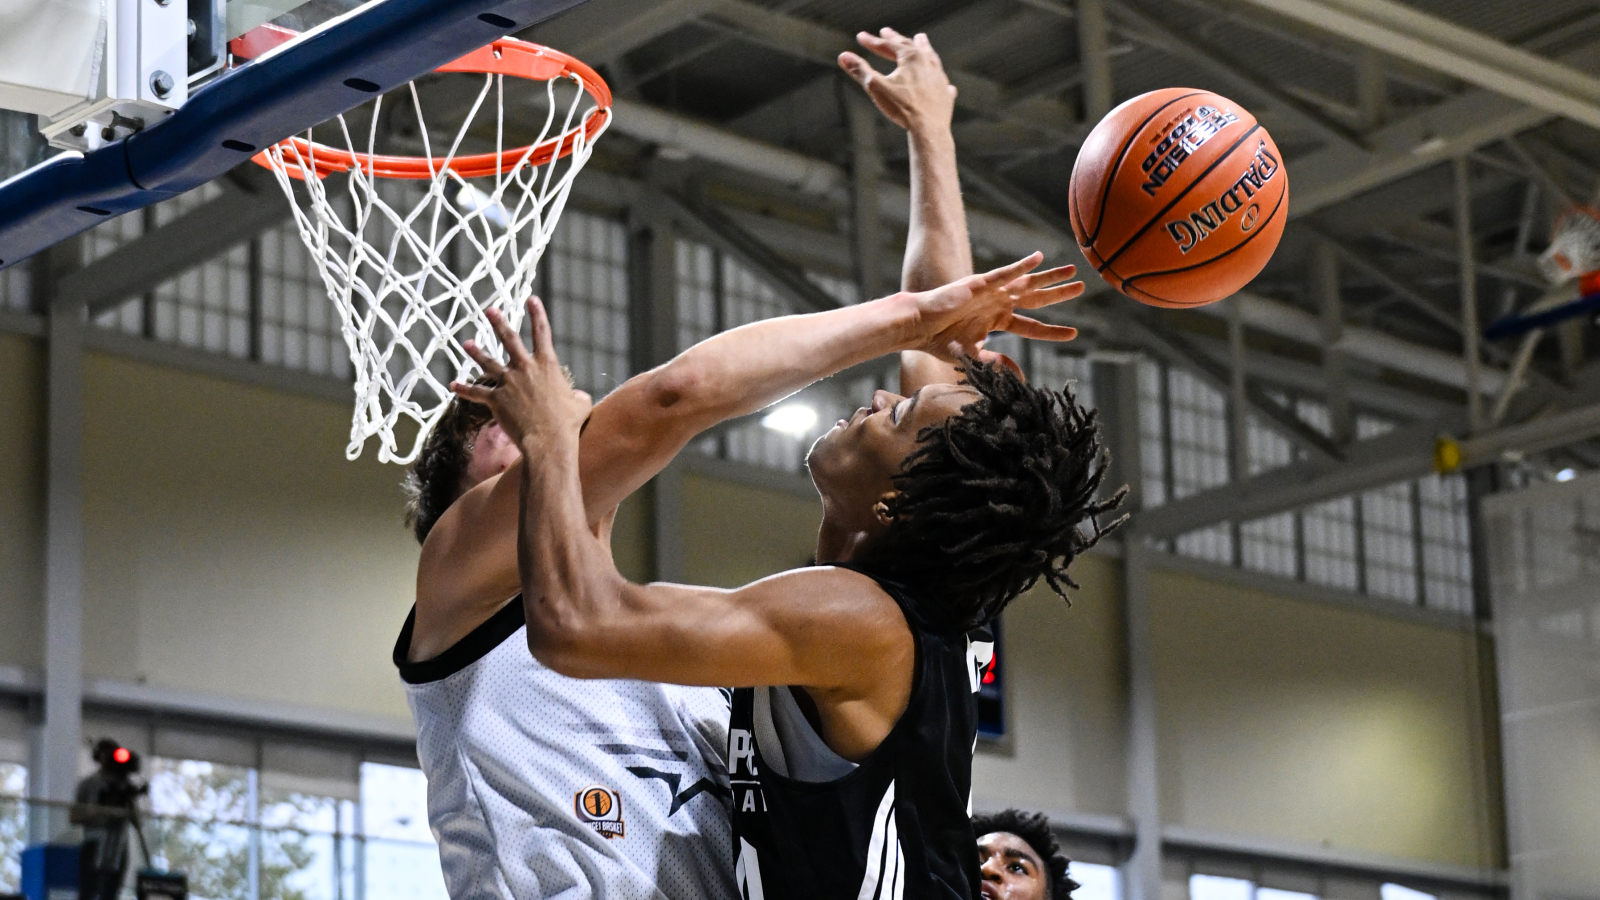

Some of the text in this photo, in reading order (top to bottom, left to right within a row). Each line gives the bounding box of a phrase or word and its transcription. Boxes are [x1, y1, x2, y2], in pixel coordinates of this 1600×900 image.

[1140, 108, 1240, 197] PRECISION
[1141, 114, 1199, 173] 1000
[1165, 138, 1278, 255] SPALDING
